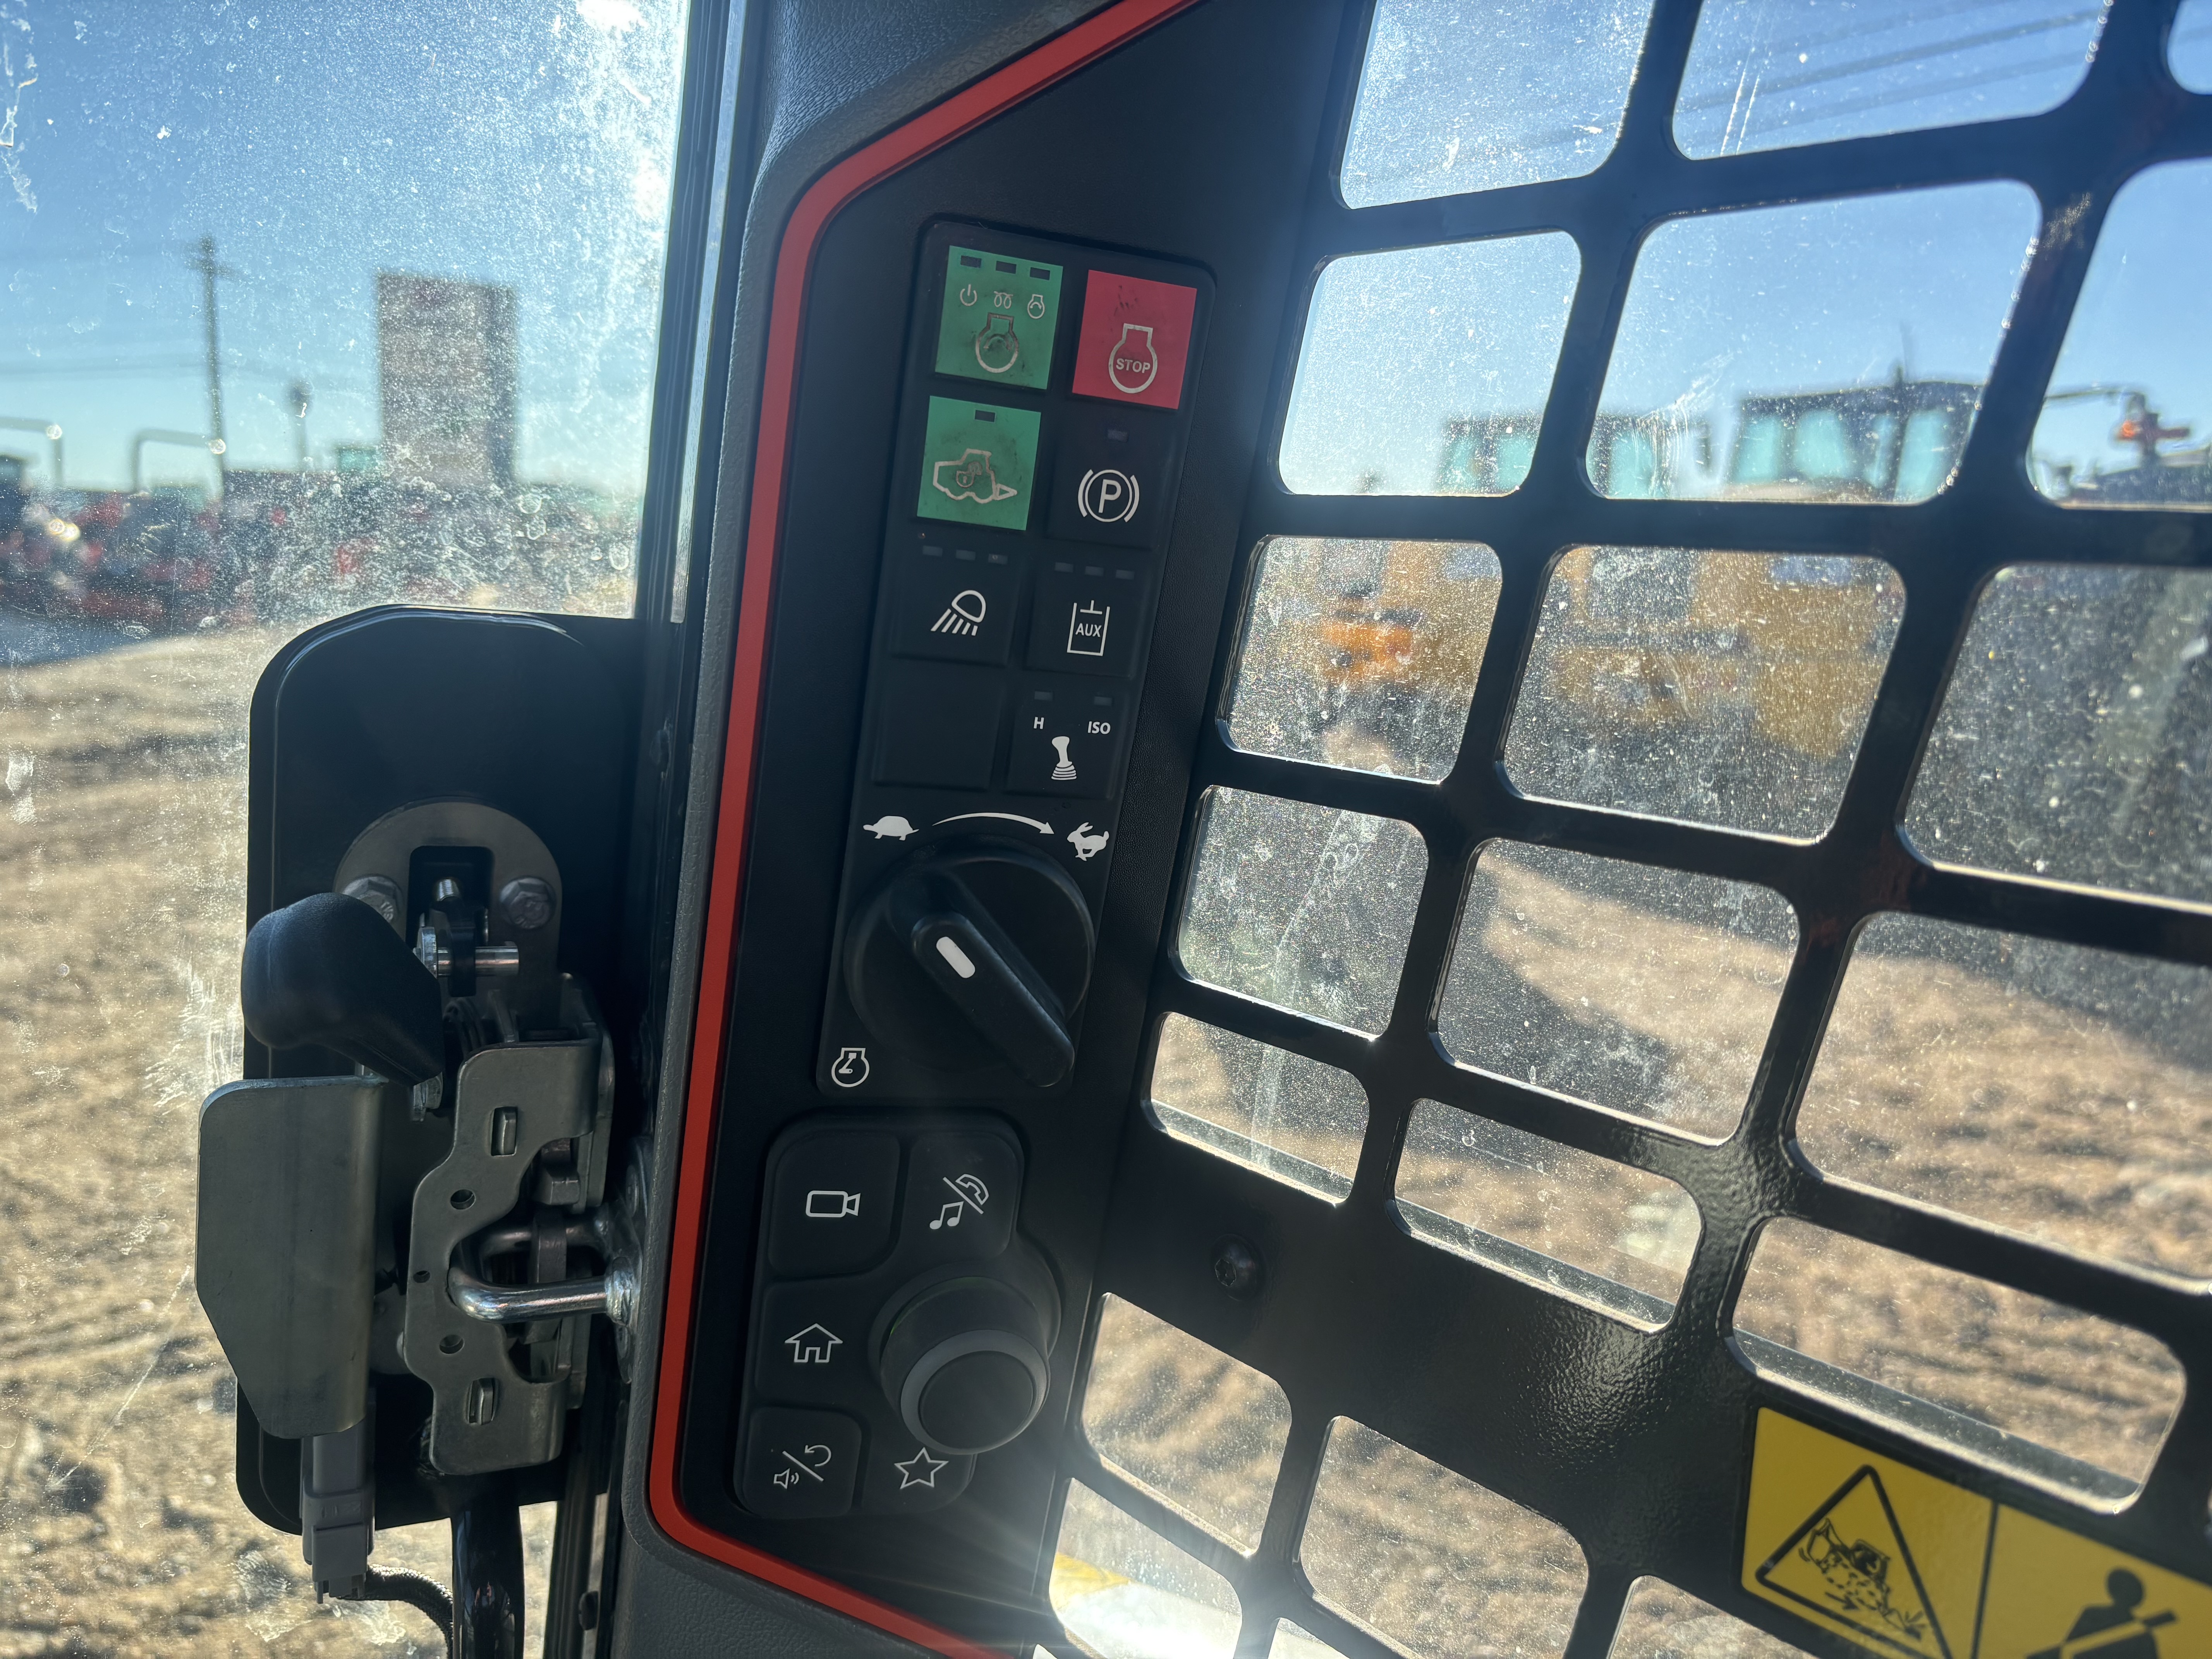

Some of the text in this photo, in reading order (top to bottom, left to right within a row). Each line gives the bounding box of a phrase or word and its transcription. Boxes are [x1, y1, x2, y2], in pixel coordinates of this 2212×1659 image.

[1116, 358, 1151, 373] STOP
[1099, 479, 1121, 514] P
[1076, 623, 1101, 637] AUX
[1034, 717, 1044, 729] H
[1087, 721, 1111, 735] ISO
